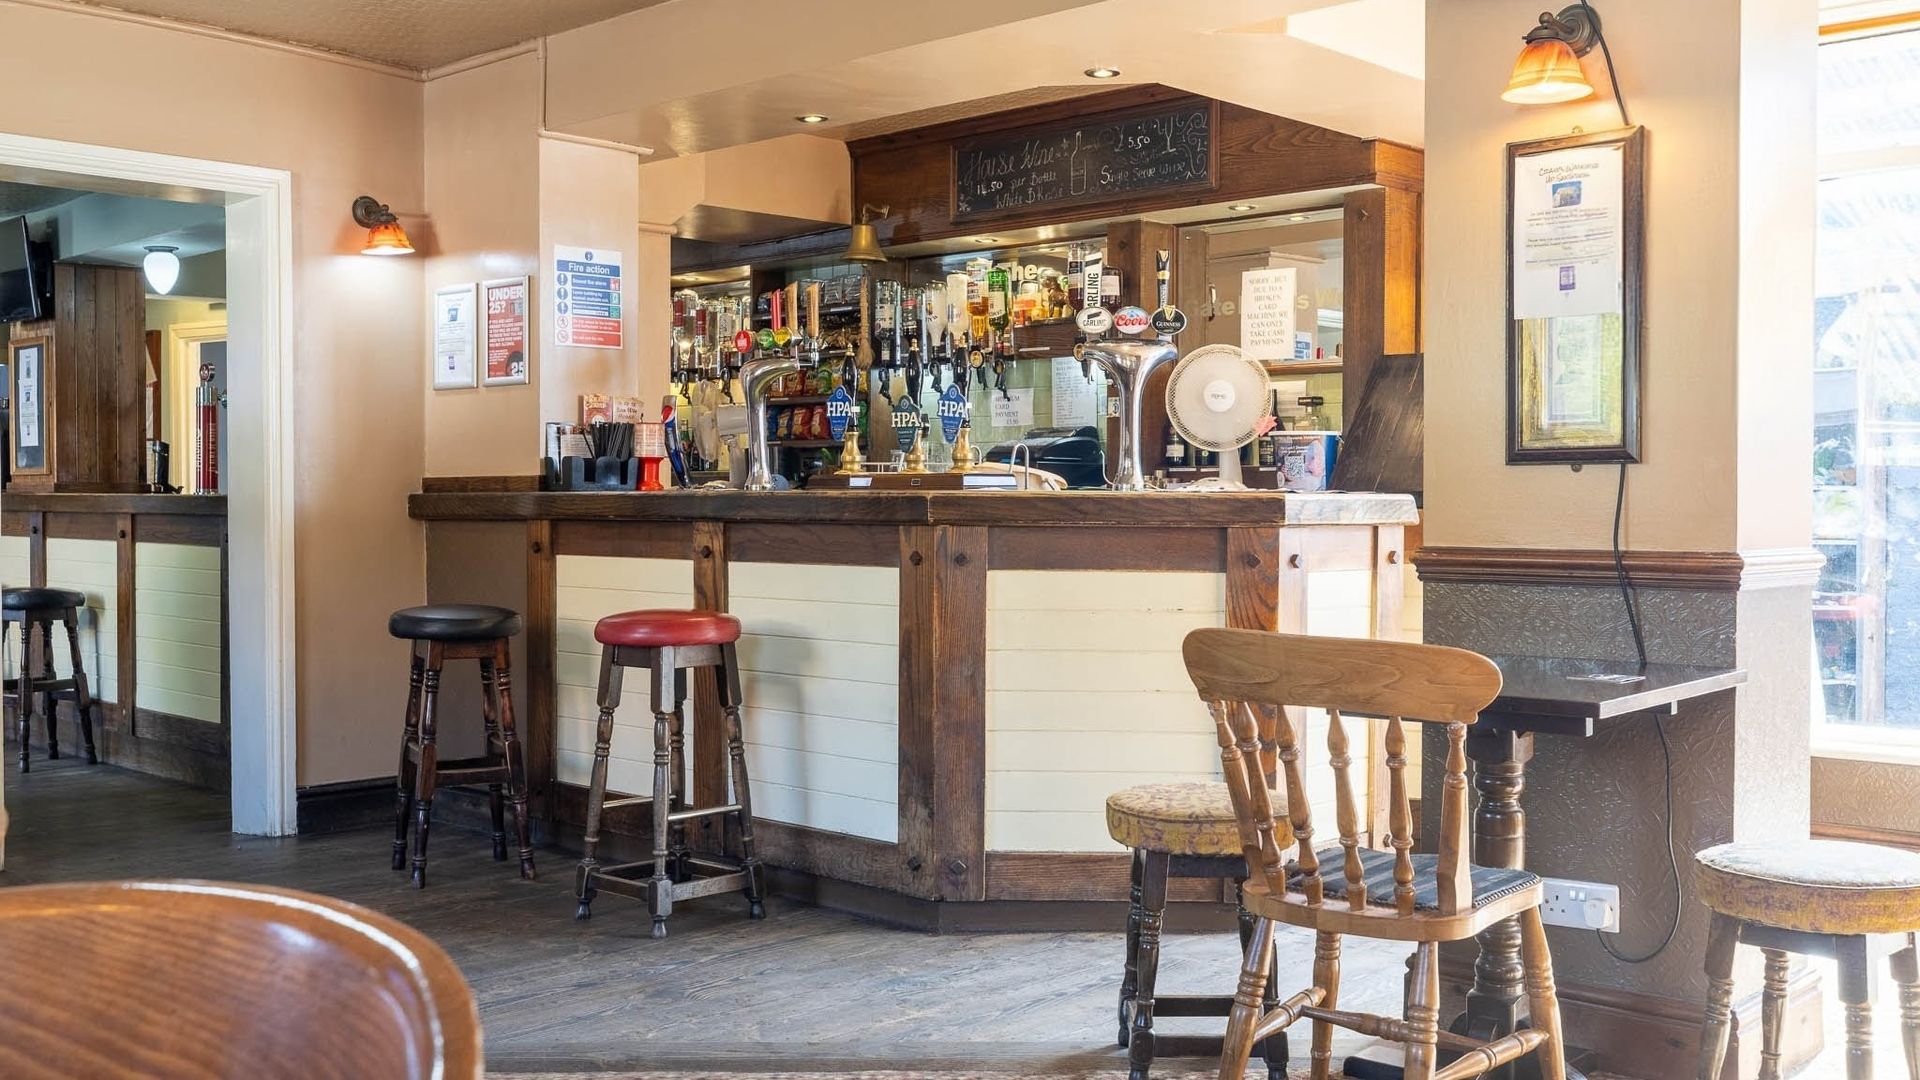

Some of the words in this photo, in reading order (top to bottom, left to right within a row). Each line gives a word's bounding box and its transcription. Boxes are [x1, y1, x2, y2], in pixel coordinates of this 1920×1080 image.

[568, 262, 584, 272] Fire
[586, 264, 610, 275] action
[489, 285, 523, 301] UNDER
[1087, 272, 1099, 308] ARLING
[489, 301, 507, 315] 25?
[1258, 303, 1278, 311] CARD
[1114, 313, 1149, 327] Coors
[1249, 329, 1267, 337] TAKE
[1250, 338, 1285, 346] PAYMENTS
[511, 361, 524, 376] 25
[827, 401, 851, 417] HPA
[938, 400, 966, 418] HPA
[891, 411, 920, 428] HPA
